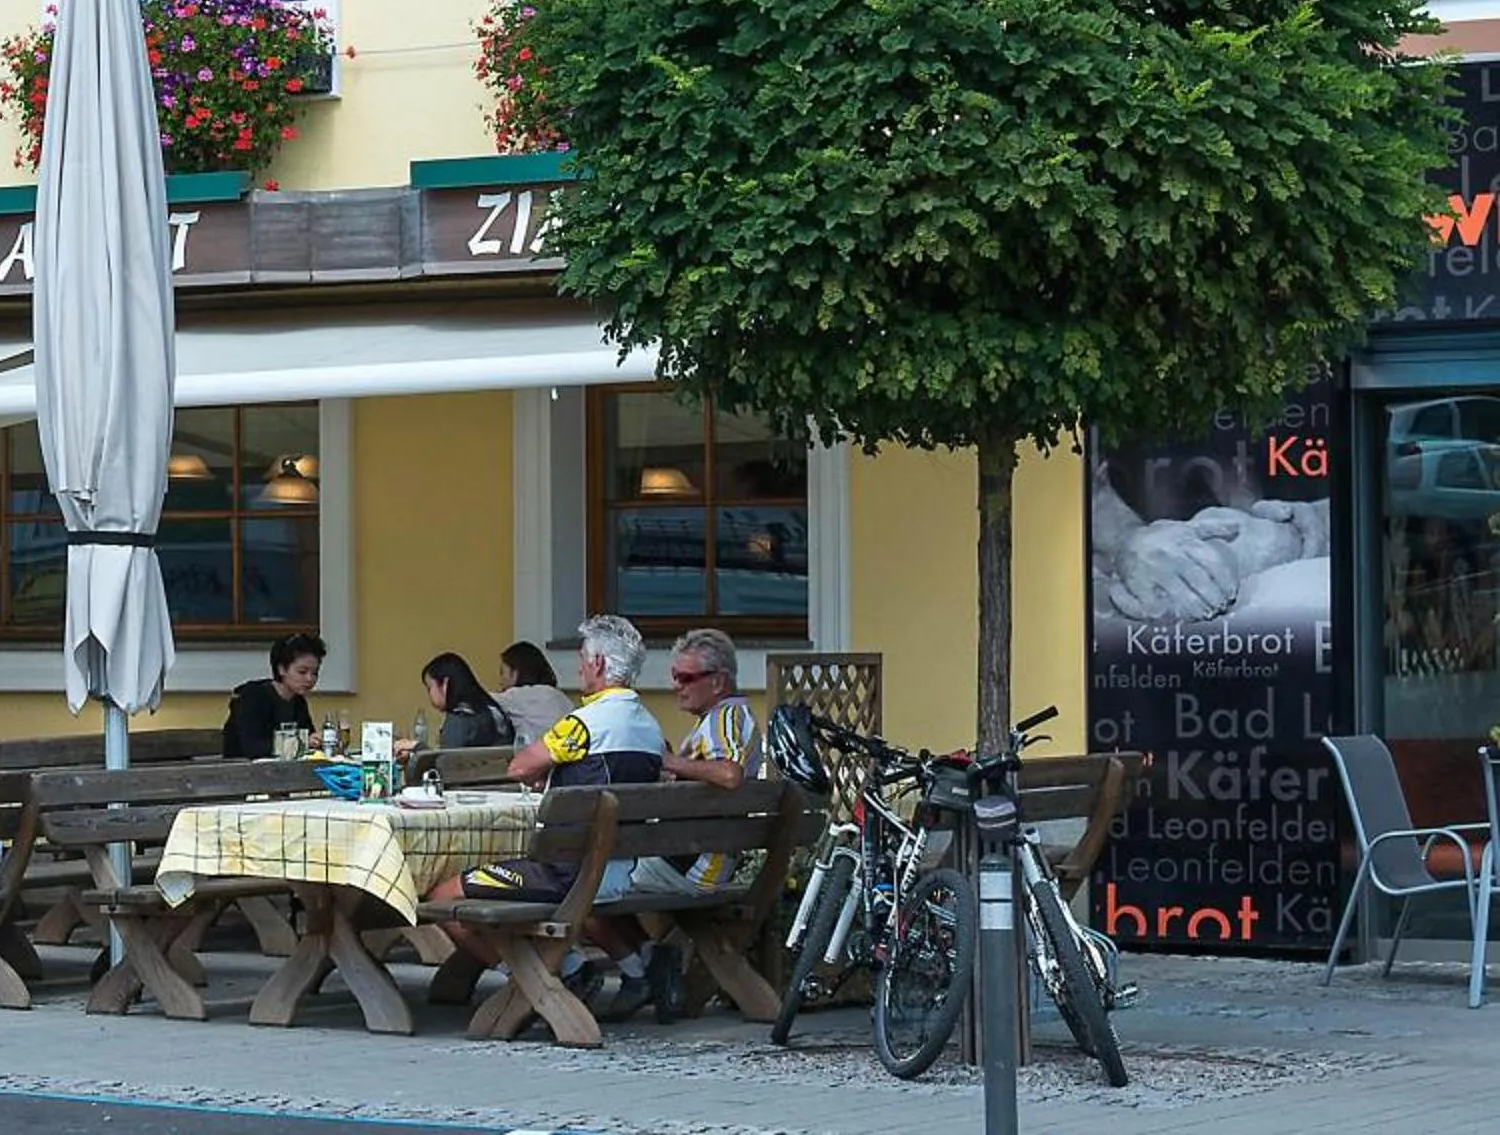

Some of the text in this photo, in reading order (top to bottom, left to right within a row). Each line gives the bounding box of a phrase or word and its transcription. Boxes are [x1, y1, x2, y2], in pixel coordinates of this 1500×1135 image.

[1268, 436, 1328, 477] Kä
[1126, 621, 1295, 655] Käferbrot
[1175, 686, 1275, 739] Bad
[1166, 745, 1329, 802] Käfer
[1111, 842, 1336, 886] Leonfelden
